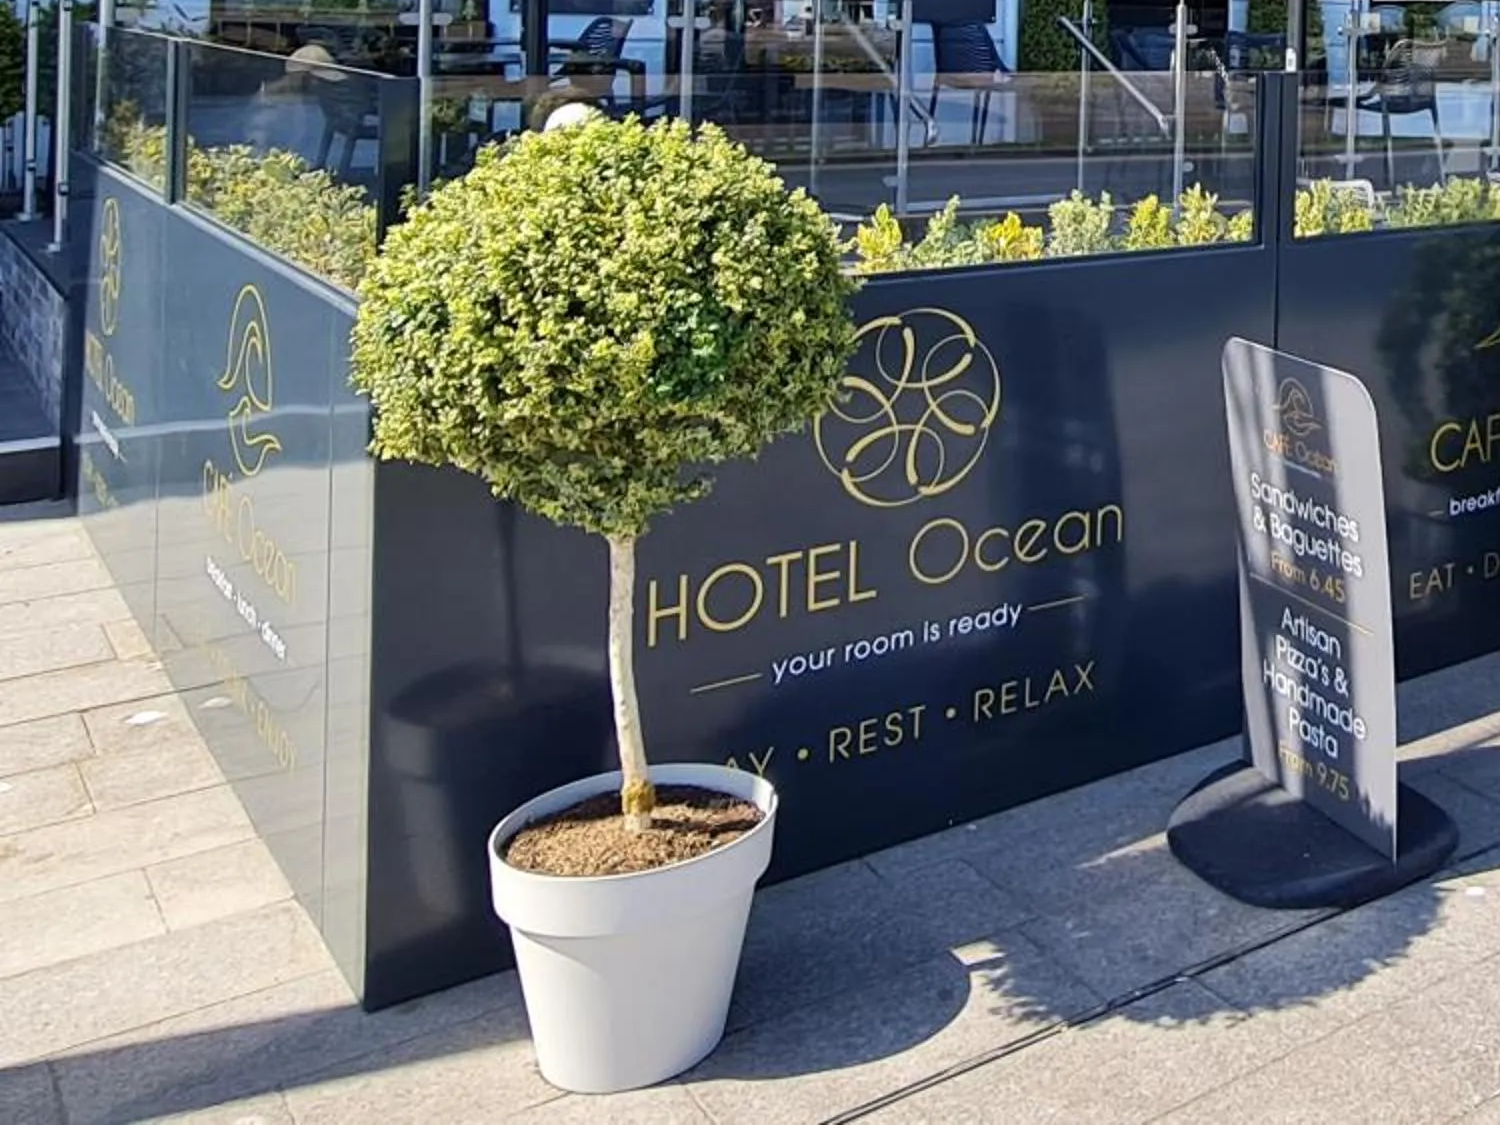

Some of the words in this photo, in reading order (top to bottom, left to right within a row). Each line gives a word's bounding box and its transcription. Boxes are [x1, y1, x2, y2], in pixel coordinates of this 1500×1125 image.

[1251, 472, 1359, 543] Sandwiches
[1253, 505, 1267, 535] &
[1270, 511, 1363, 578] Baguettes
[647, 540, 877, 648] HOTEL
[908, 503, 1123, 584] Ocean
[1271, 550, 1307, 584] From
[1309, 568, 1346, 604] 6.45
[1409, 561, 1456, 601] EAT
[771, 646, 834, 684] your
[844, 628, 914, 662] room
[923, 620, 941, 644] is
[949, 601, 1024, 637] ready
[1275, 633, 1331, 688] Pizza's
[1333, 666, 1349, 698] &
[1281, 606, 1341, 660] Artisan
[828, 706, 927, 764] REST
[973, 662, 1096, 723] RELAX
[1263, 658, 1367, 740] Handmade
[1289, 706, 1339, 759] Pasta
[1279, 739, 1313, 778] From
[1316, 761, 1350, 801] 9.75
